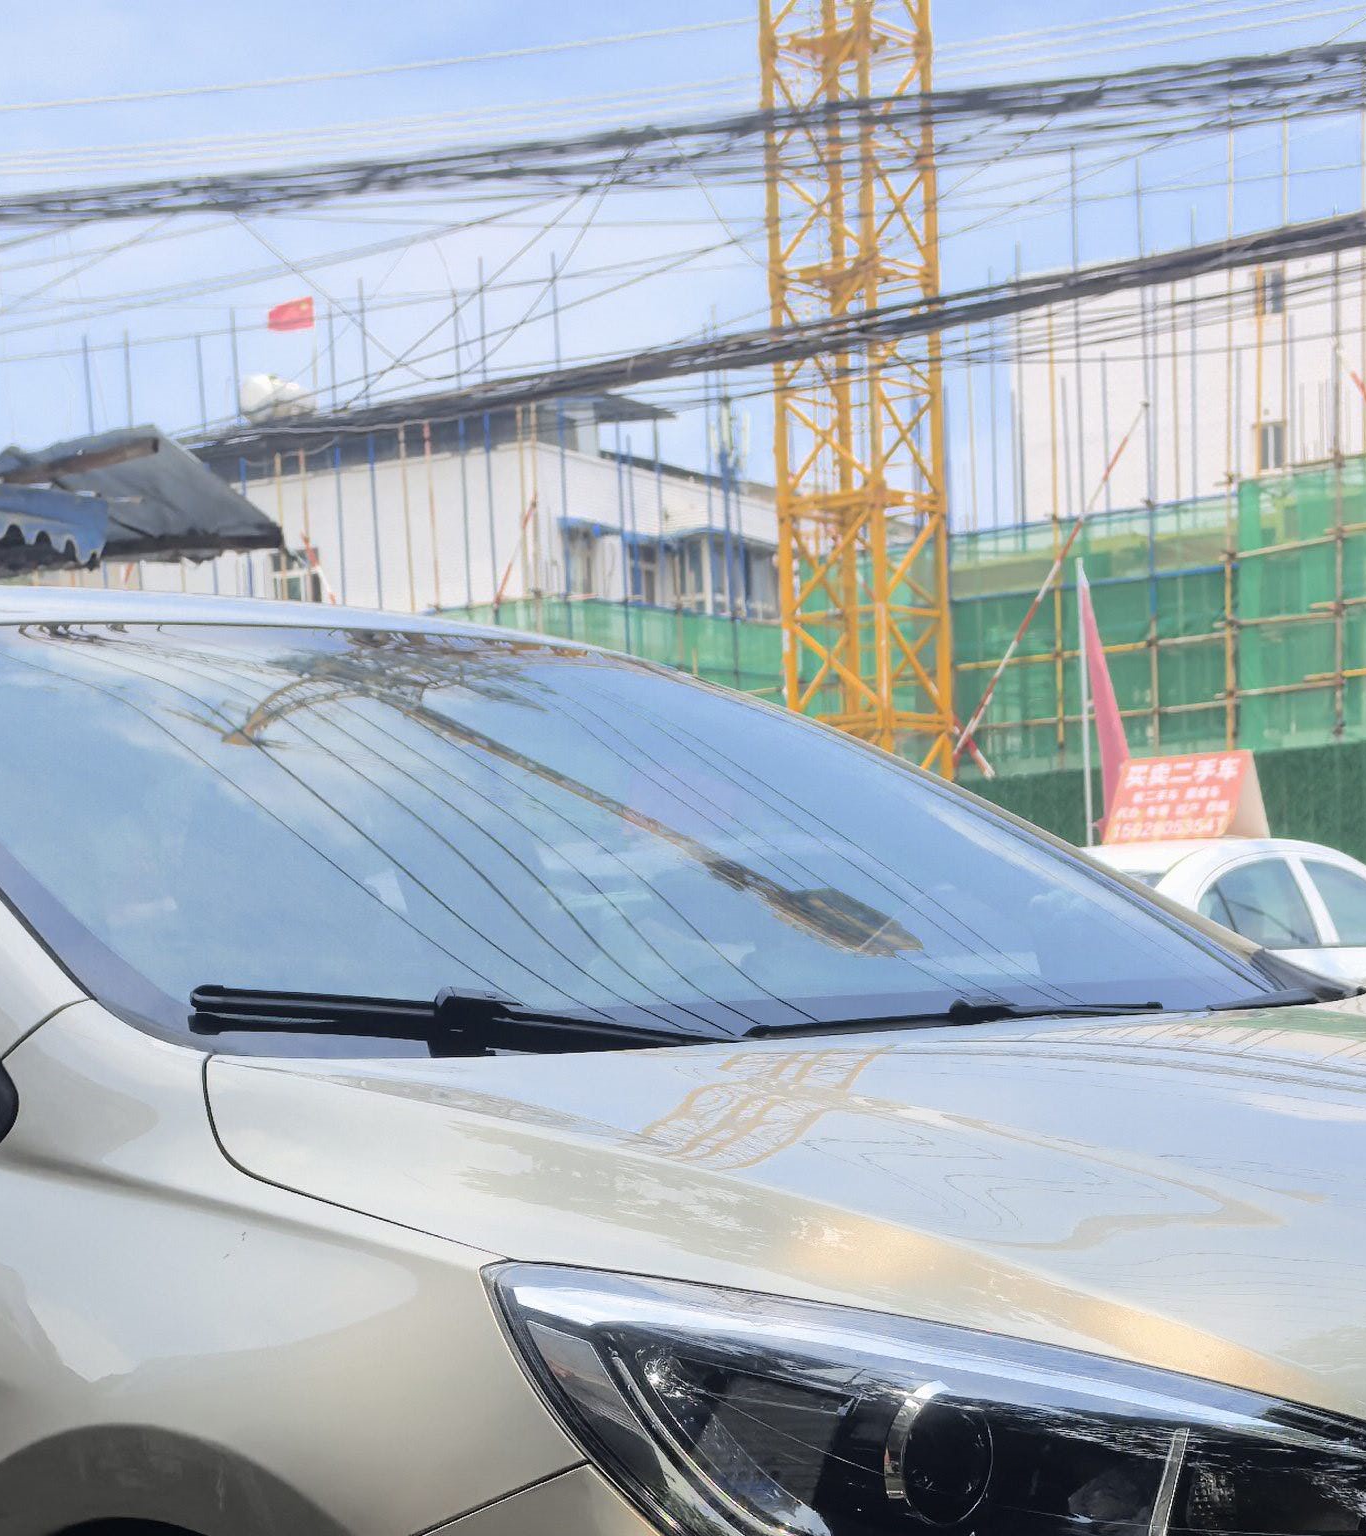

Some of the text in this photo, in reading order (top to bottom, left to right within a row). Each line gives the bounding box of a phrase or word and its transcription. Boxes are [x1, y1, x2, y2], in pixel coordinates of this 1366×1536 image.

[1125, 758, 1240, 787] 买卖二手车
